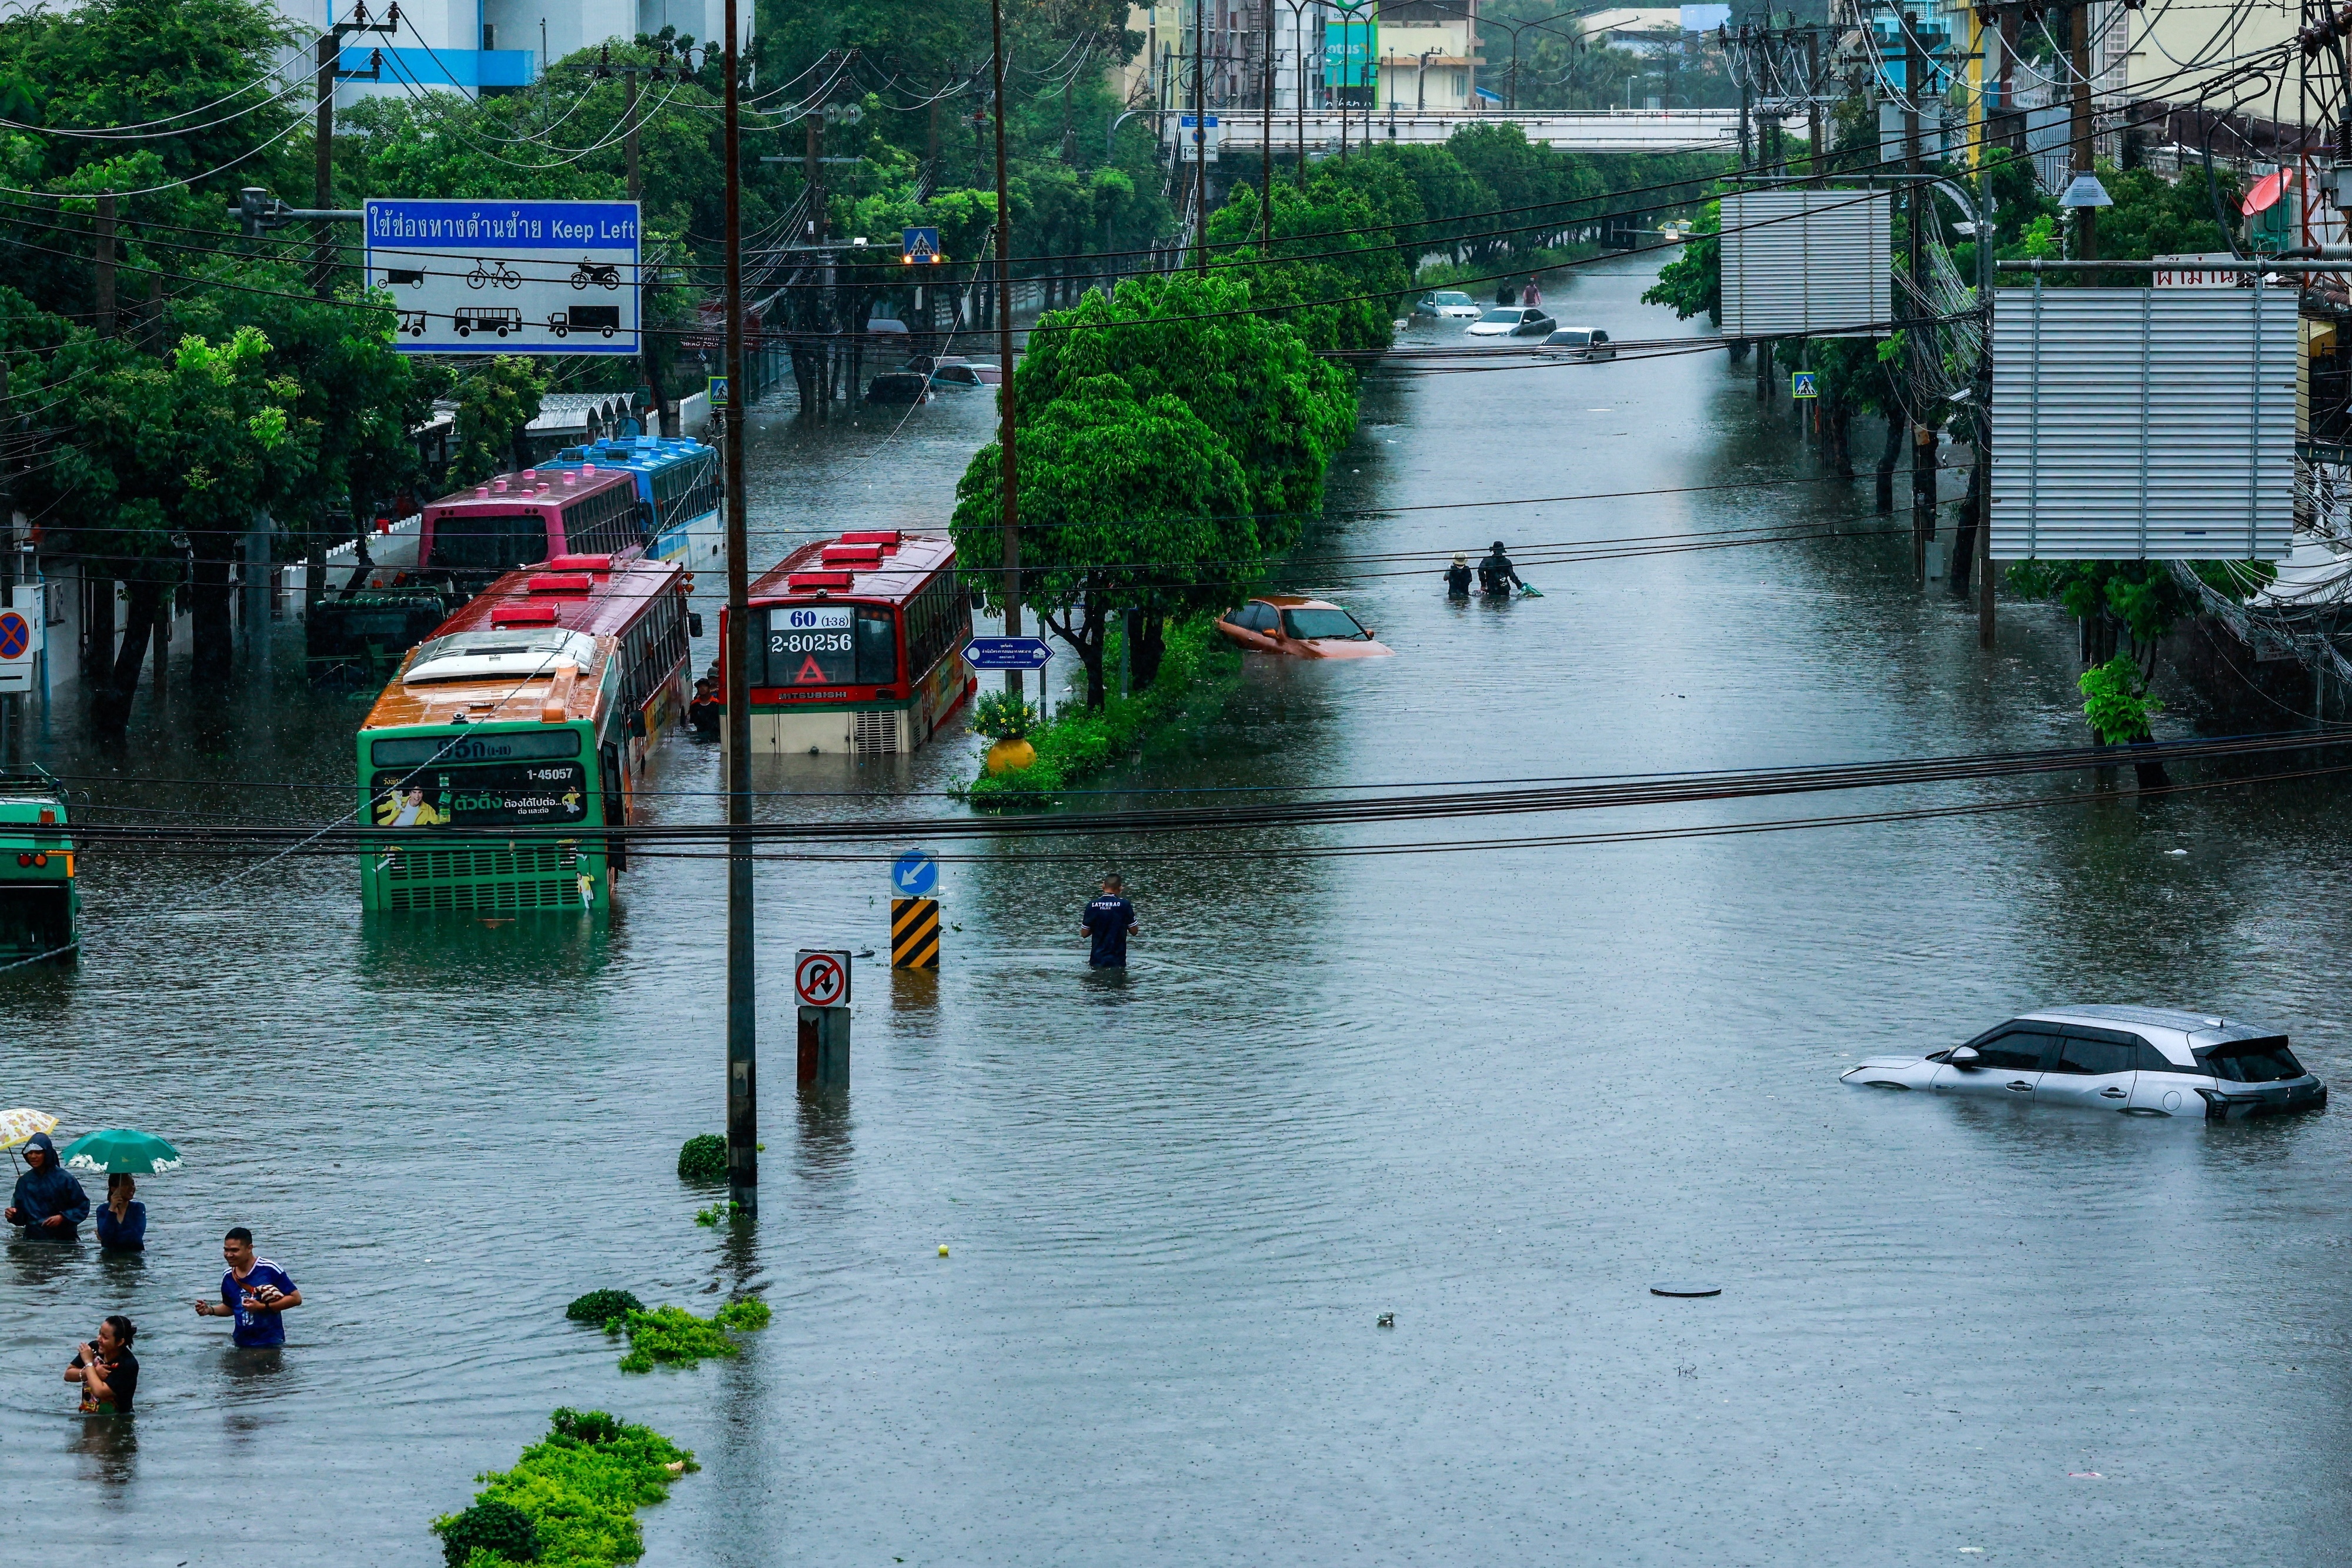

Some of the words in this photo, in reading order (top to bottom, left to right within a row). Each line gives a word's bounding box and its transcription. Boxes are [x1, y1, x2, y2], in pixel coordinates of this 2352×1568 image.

[370, 206, 542, 238] ใช้ช่องทางด้านซ้าย
[552, 220, 594, 243] Keep
[601, 220, 634, 239] Left
[790, 611, 817, 627] 60
[821, 615, 848, 627] (1-38)
[771, 634, 852, 653] 2-80256
[779, 691, 847, 700] MITSUBISHI
[527, 768, 573, 780] 1-45057
[455, 793, 503, 811] ตัวตึง
